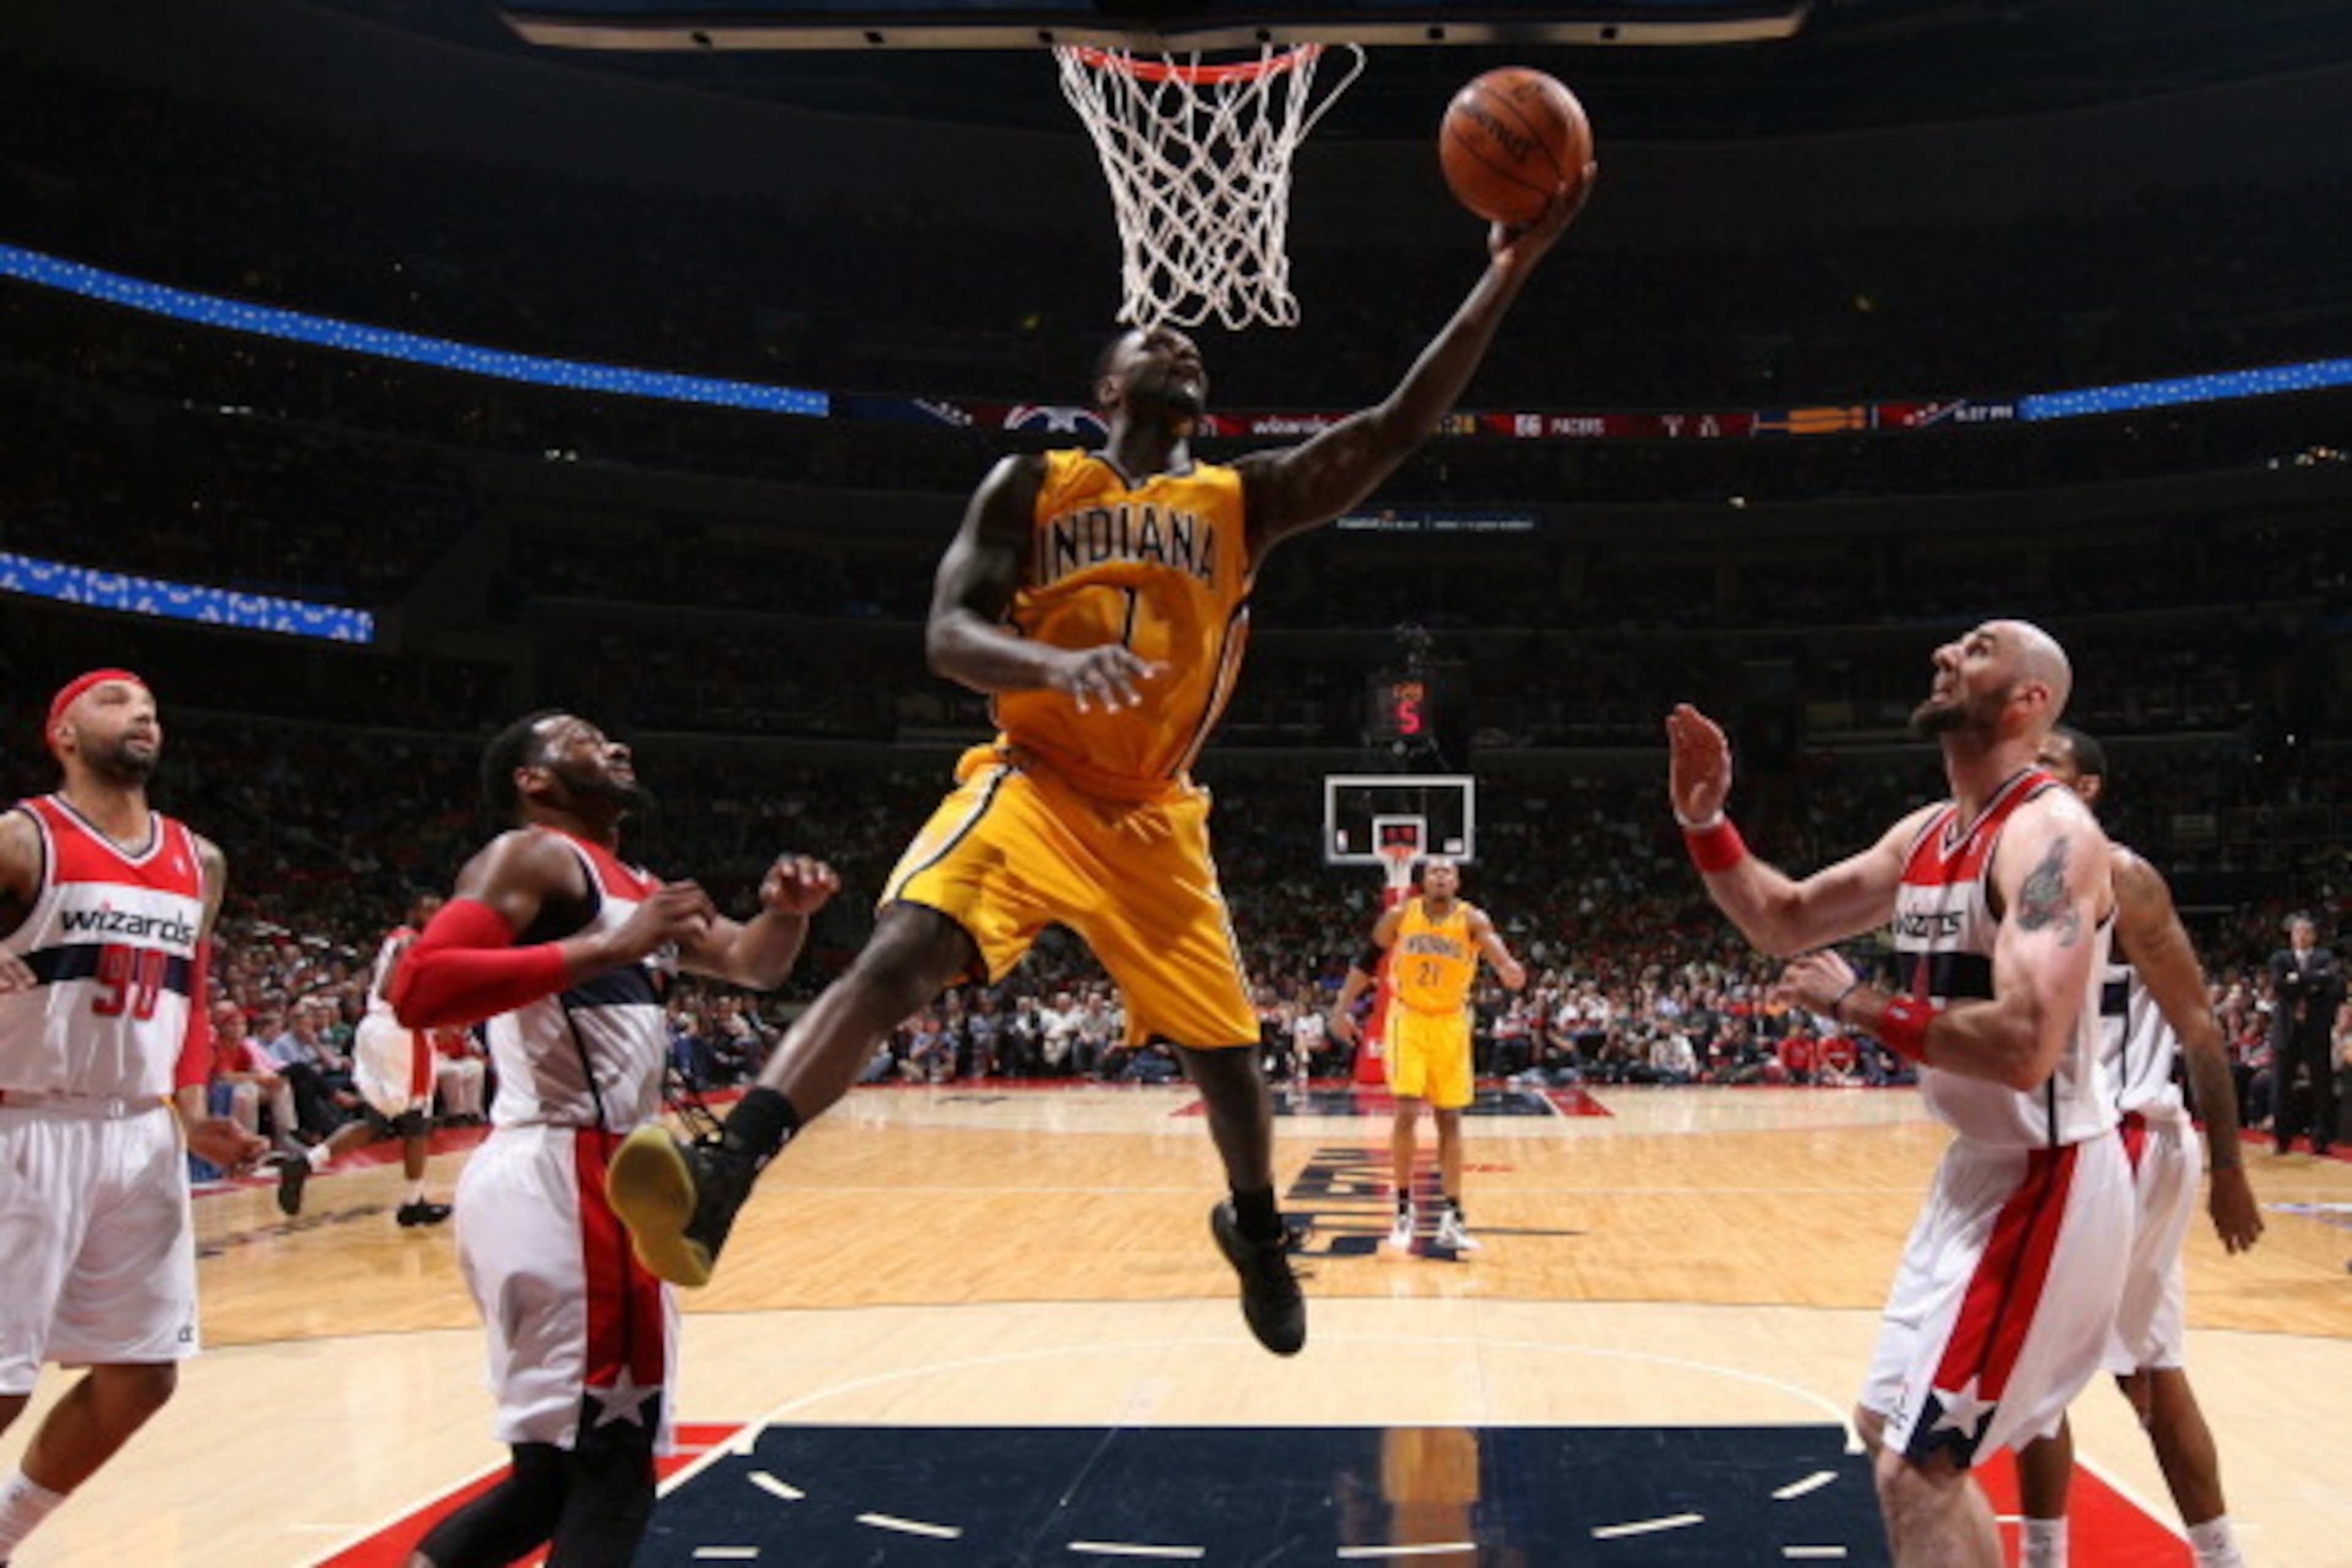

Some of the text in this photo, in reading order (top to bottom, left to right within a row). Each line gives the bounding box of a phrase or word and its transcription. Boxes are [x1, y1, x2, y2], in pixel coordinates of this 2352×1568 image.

[1035, 502, 1218, 589] INDIANA
[61, 900, 194, 945] wizards
[92, 944, 167, 1020] 90
